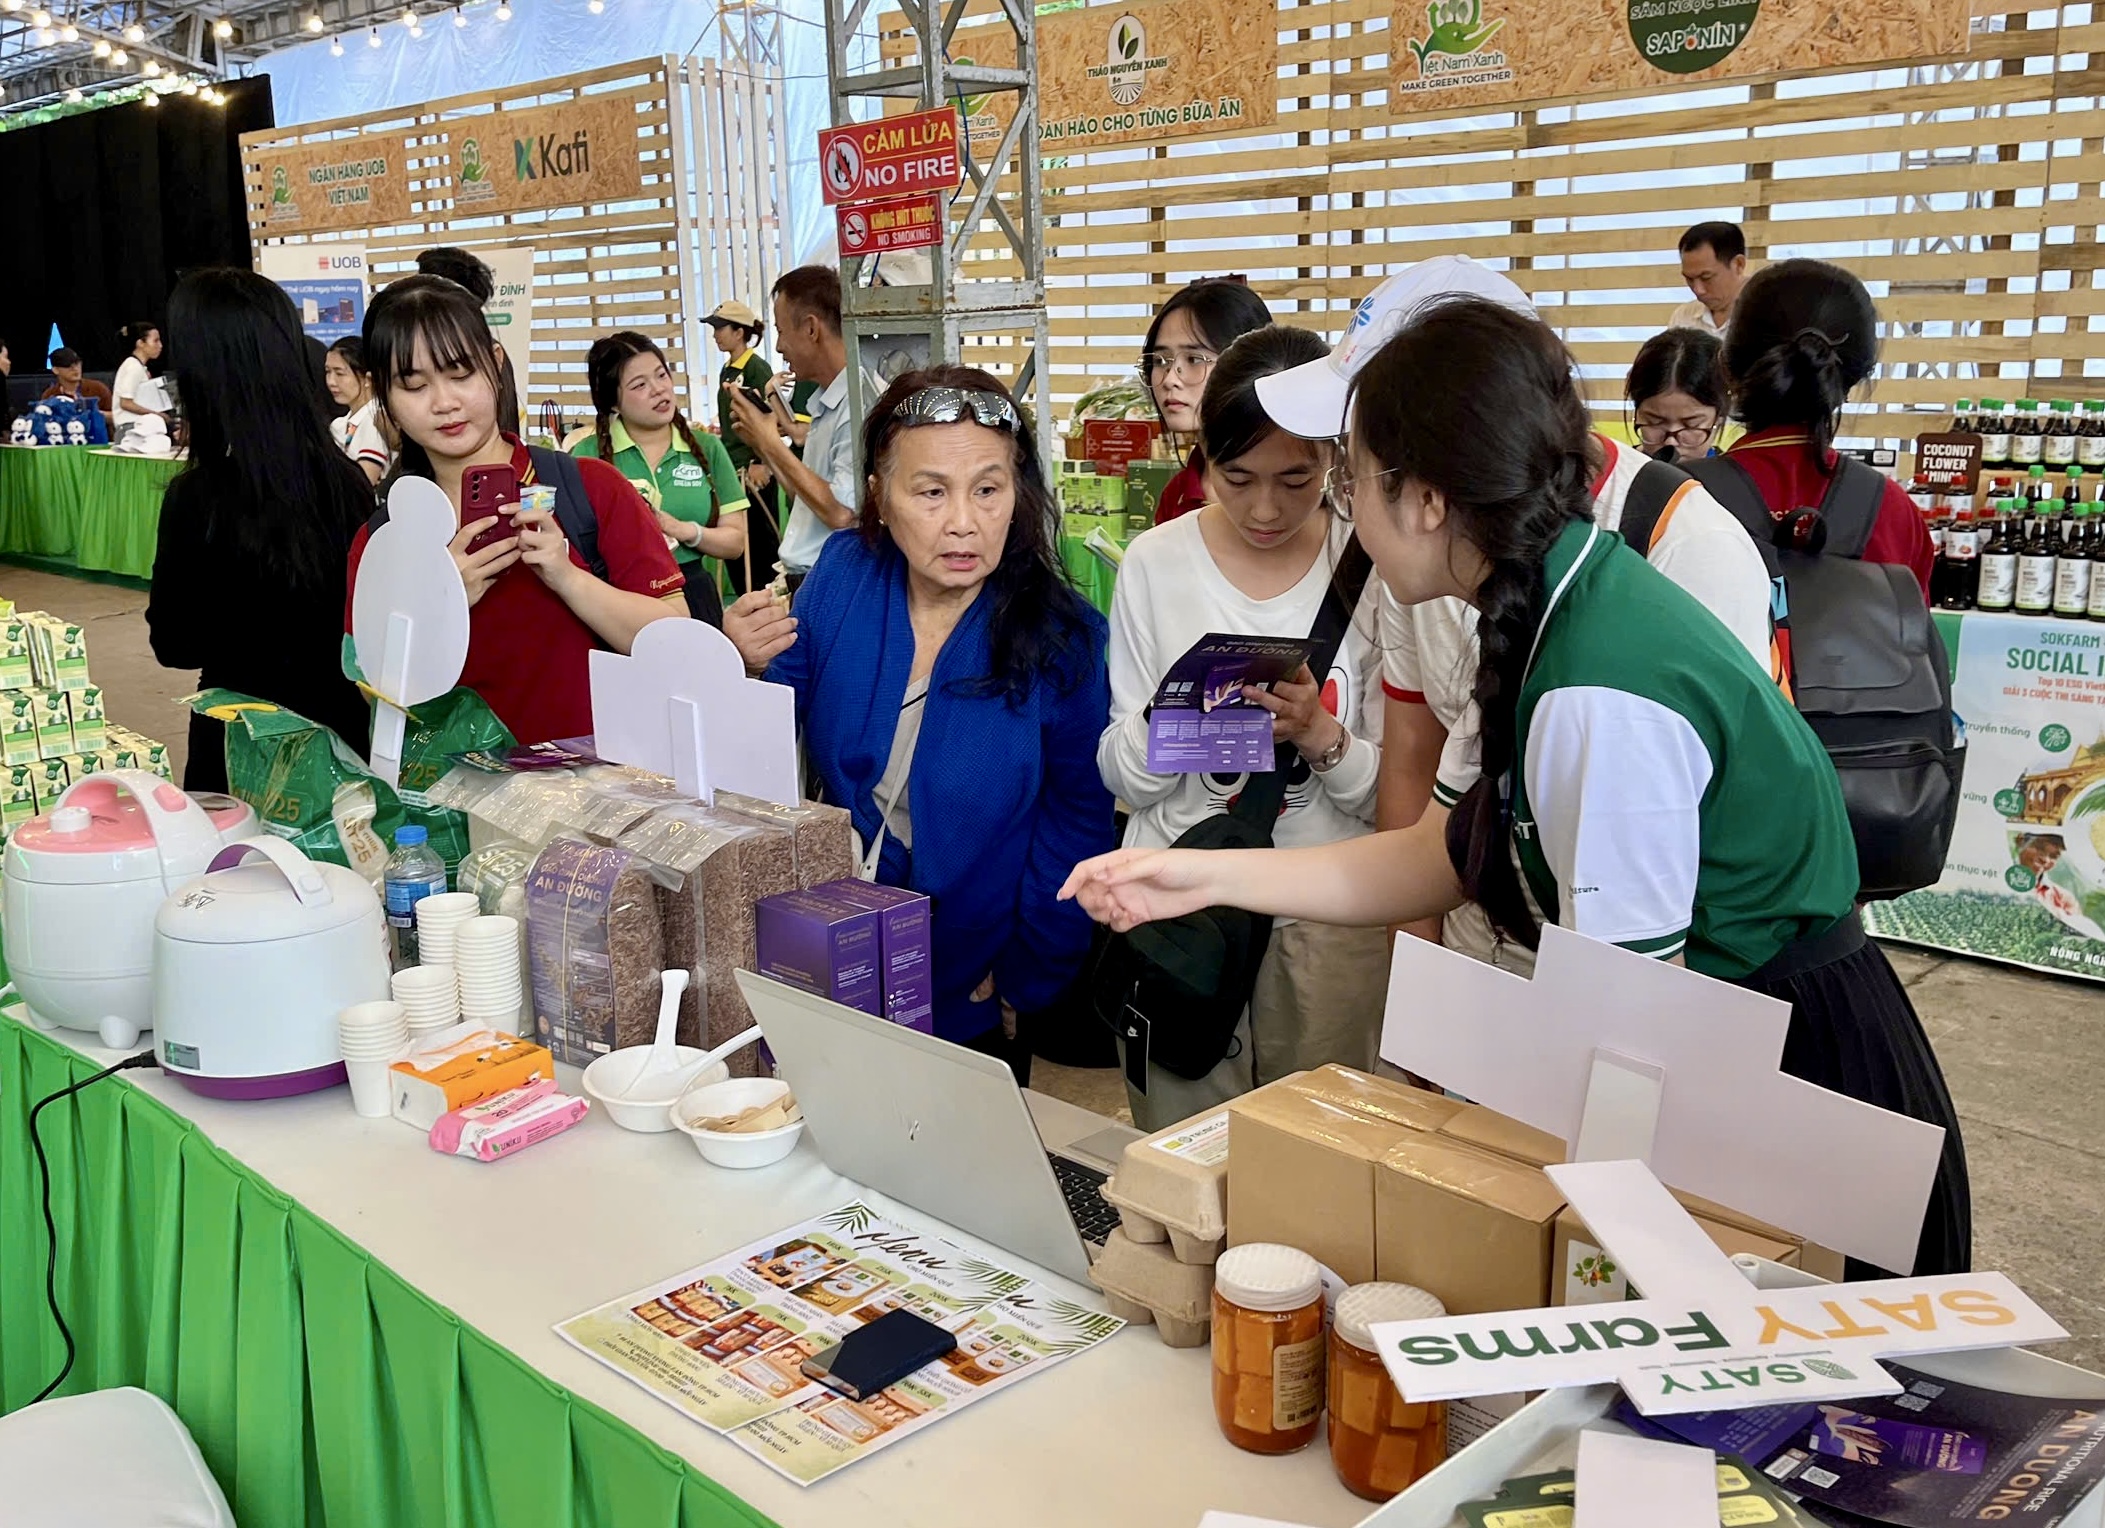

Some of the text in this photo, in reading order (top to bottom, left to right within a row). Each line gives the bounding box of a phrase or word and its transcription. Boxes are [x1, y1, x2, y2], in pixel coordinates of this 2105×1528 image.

[1145, 57, 1168, 70] XANH
[1442, 57, 1471, 71] Nam
[1473, 52, 1504, 68] Xanh
[1401, 71, 1511, 92] MAKE GREEN TOGETHER
[1066, 114, 1098, 136] HẢO
[1102, 114, 1135, 132] CHO
[1138, 105, 1178, 127] TỪNG
[1217, 95, 1242, 117] ĂN
[863, 118, 953, 154] CẤM LỬA
[539, 129, 590, 178] Kafi
[309, 158, 387, 183] NGÂN HÀNG UOB
[865, 155, 956, 188] NO FIRE
[328, 185, 370, 205] VIỆT NAM
[877, 227, 931, 246] NO SMOKING
[332, 256, 361, 270] UOB
[1923, 443, 1975, 457] COCONUT
[1922, 457, 1967, 470] FLOWER
[2040, 632, 2101, 648] SOKFARM
[2006, 647, 2089, 675] SOCIAL
[2000, 725, 2031, 739] thống
[1962, 791, 1988, 804] vững
[535, 877, 554, 891] AN
[2050, 945, 2081, 962] NÔNG
[1399, 1289, 2018, 1365] SATY Farms
[1661, 1363, 1807, 1395] SATY
[1978, 1409, 2099, 1521] AN DUONG
[2022, 1487, 2058, 1513] RICE
